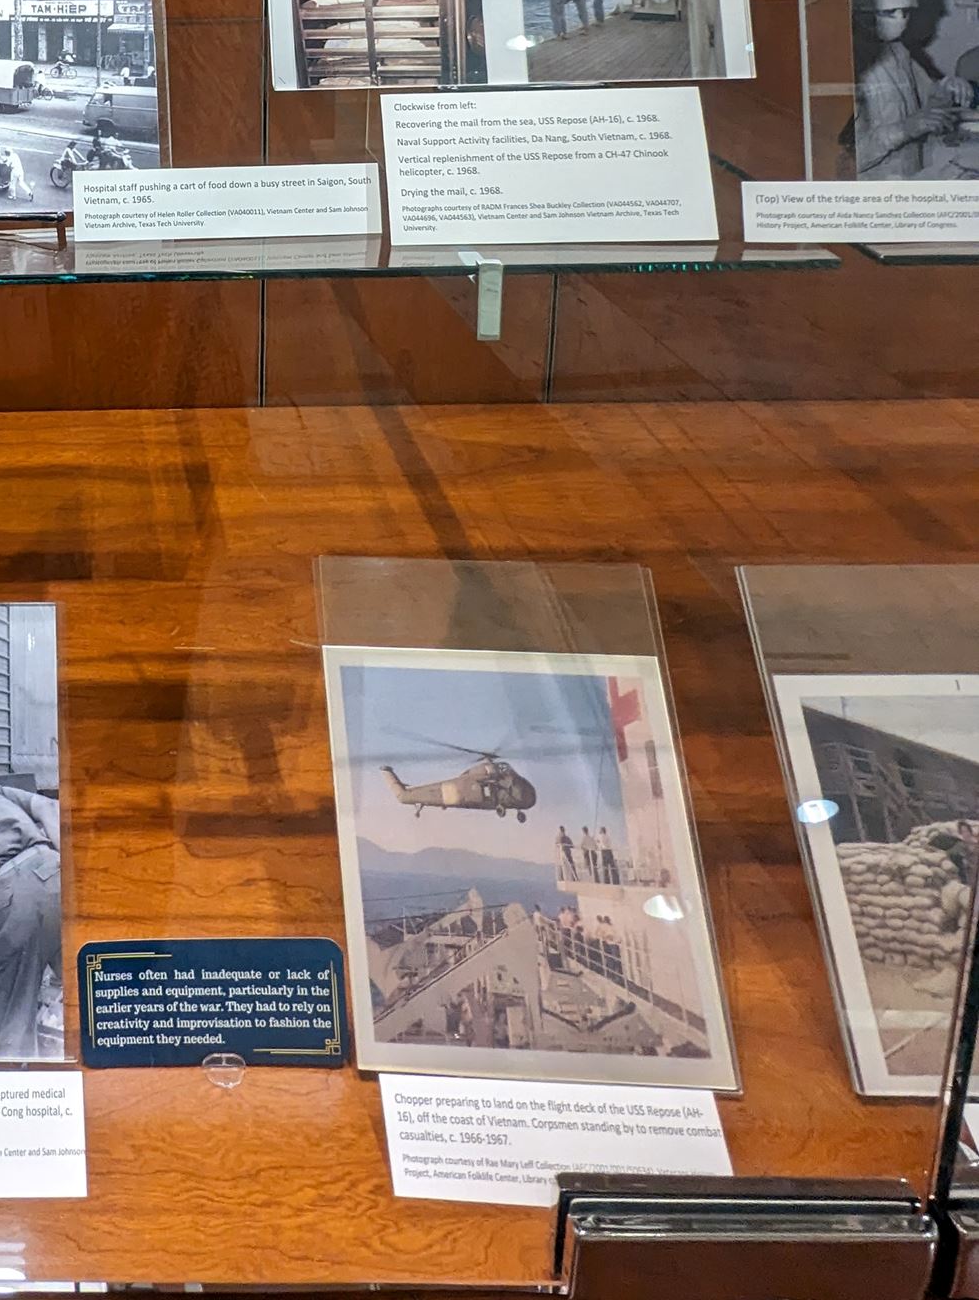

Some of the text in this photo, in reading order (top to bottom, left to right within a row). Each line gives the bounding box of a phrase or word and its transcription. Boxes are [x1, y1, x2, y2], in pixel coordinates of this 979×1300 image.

[393, 101, 476, 111] Clockwise from left:
[395, 119, 442, 129] Recovering
[443, 119, 458, 127] the
[460, 118, 478, 127] mail
[480, 118, 501, 126] from
[537, 116, 554, 125] USS
[556, 116, 588, 125] Repose
[83, 183, 116, 193] Hospital
[118, 183, 137, 191] staff
[139, 182, 171, 192] pushing
[179, 182, 195, 190] cart
[197, 180, 206, 189] of
[208, 180, 227, 189] food
[228, 180, 251, 188] down
[260, 179, 279, 188] busy
[281, 179, 305, 187] street
[307, 178, 315, 186] in
[347, 175, 371, 185] South
[755, 194, 779, 204] (Top)
[781, 194, 804, 203] View
[805, 194, 815, 203] of
[817, 194, 832, 203] the
[834, 195, 860, 204] triage
[883, 193, 893, 202] of
[894, 194, 909, 203] the
[94, 968, 330, 981] Nurses often had inadequate or lack of
[95, 985, 139, 999] supplies
[141, 985, 162, 996] and
[228, 984, 294, 998] particularly
[296, 984, 308, 995] in
[310, 985, 329, 996] the
[31, 1087, 65, 1098] medical
